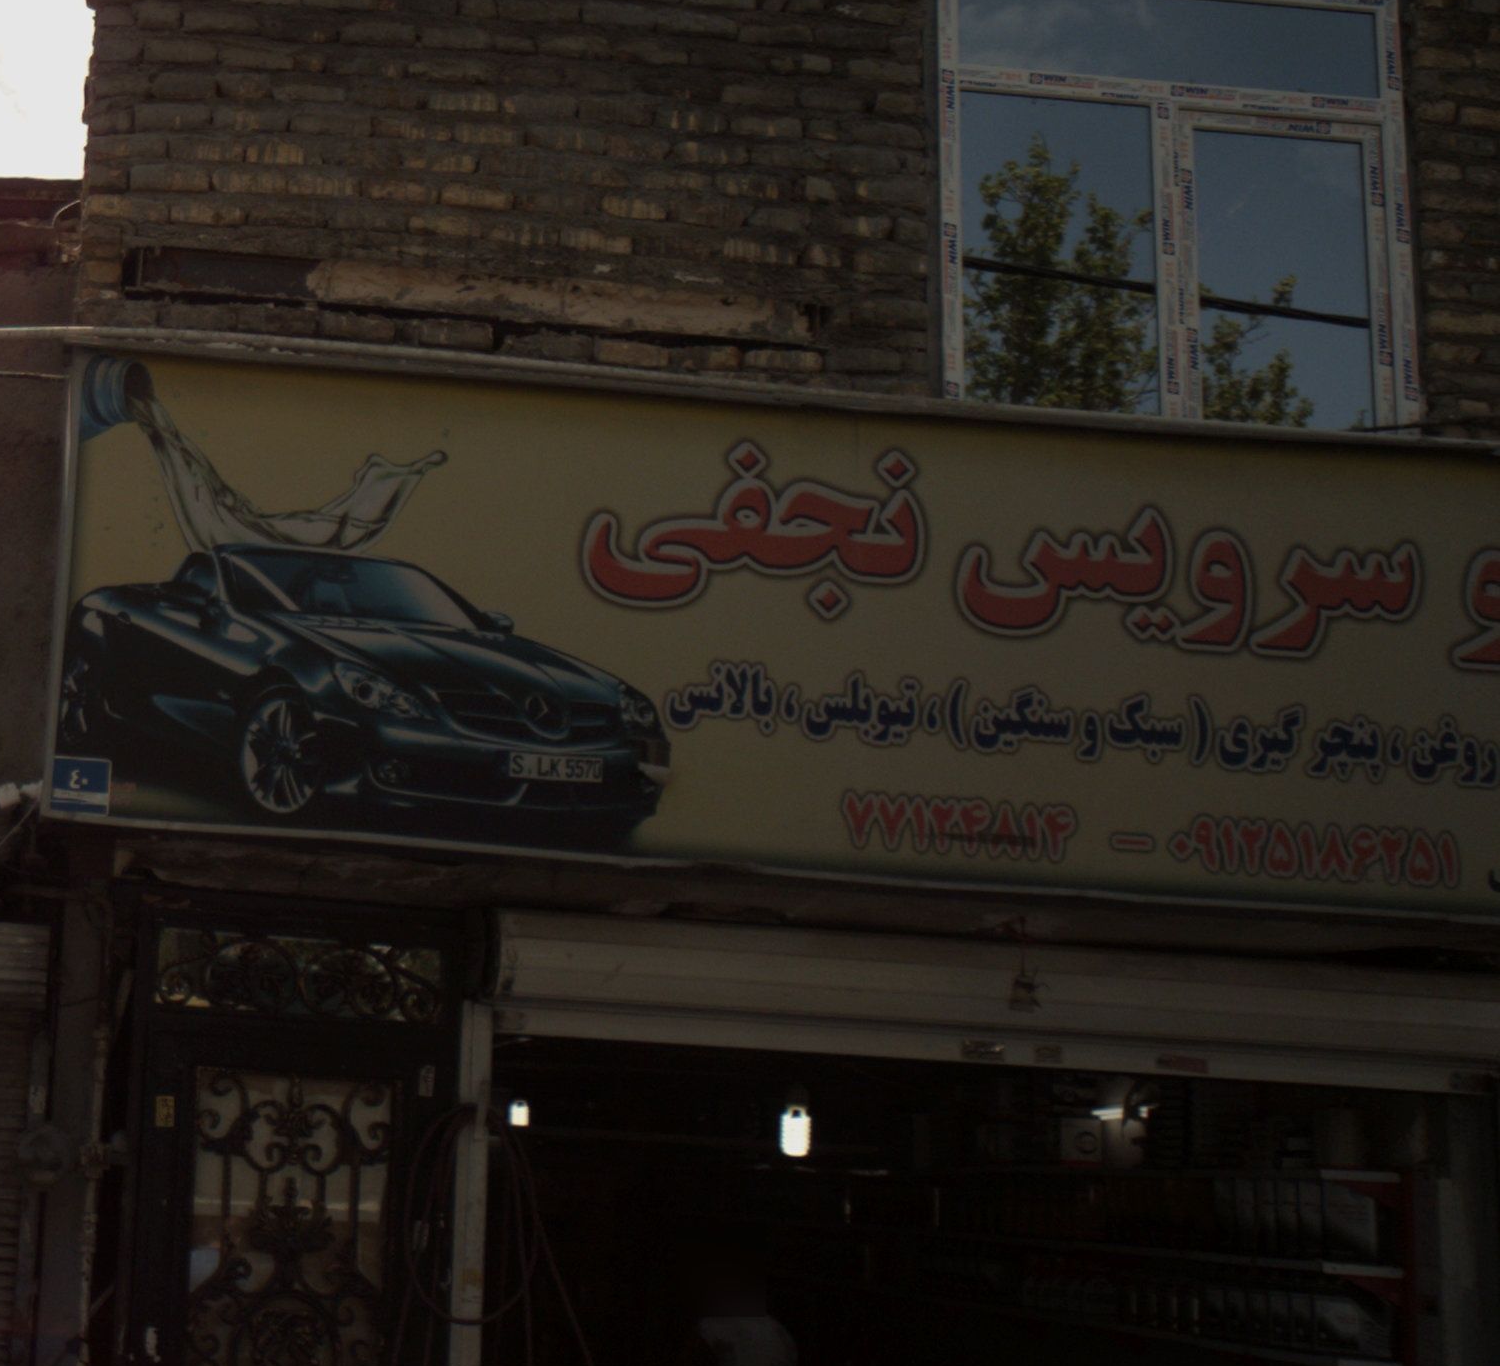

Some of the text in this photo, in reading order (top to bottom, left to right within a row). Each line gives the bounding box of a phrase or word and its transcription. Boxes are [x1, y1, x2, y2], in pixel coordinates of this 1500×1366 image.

[583, 441, 928, 620] نجفی
[959, 507, 1420, 656] سرویس
[666, 661, 777, 733] بالانس
[1077, 711, 1100, 760] و
[1218, 705, 1304, 772] گیری
[1307, 716, 1383, 781] پنچر
